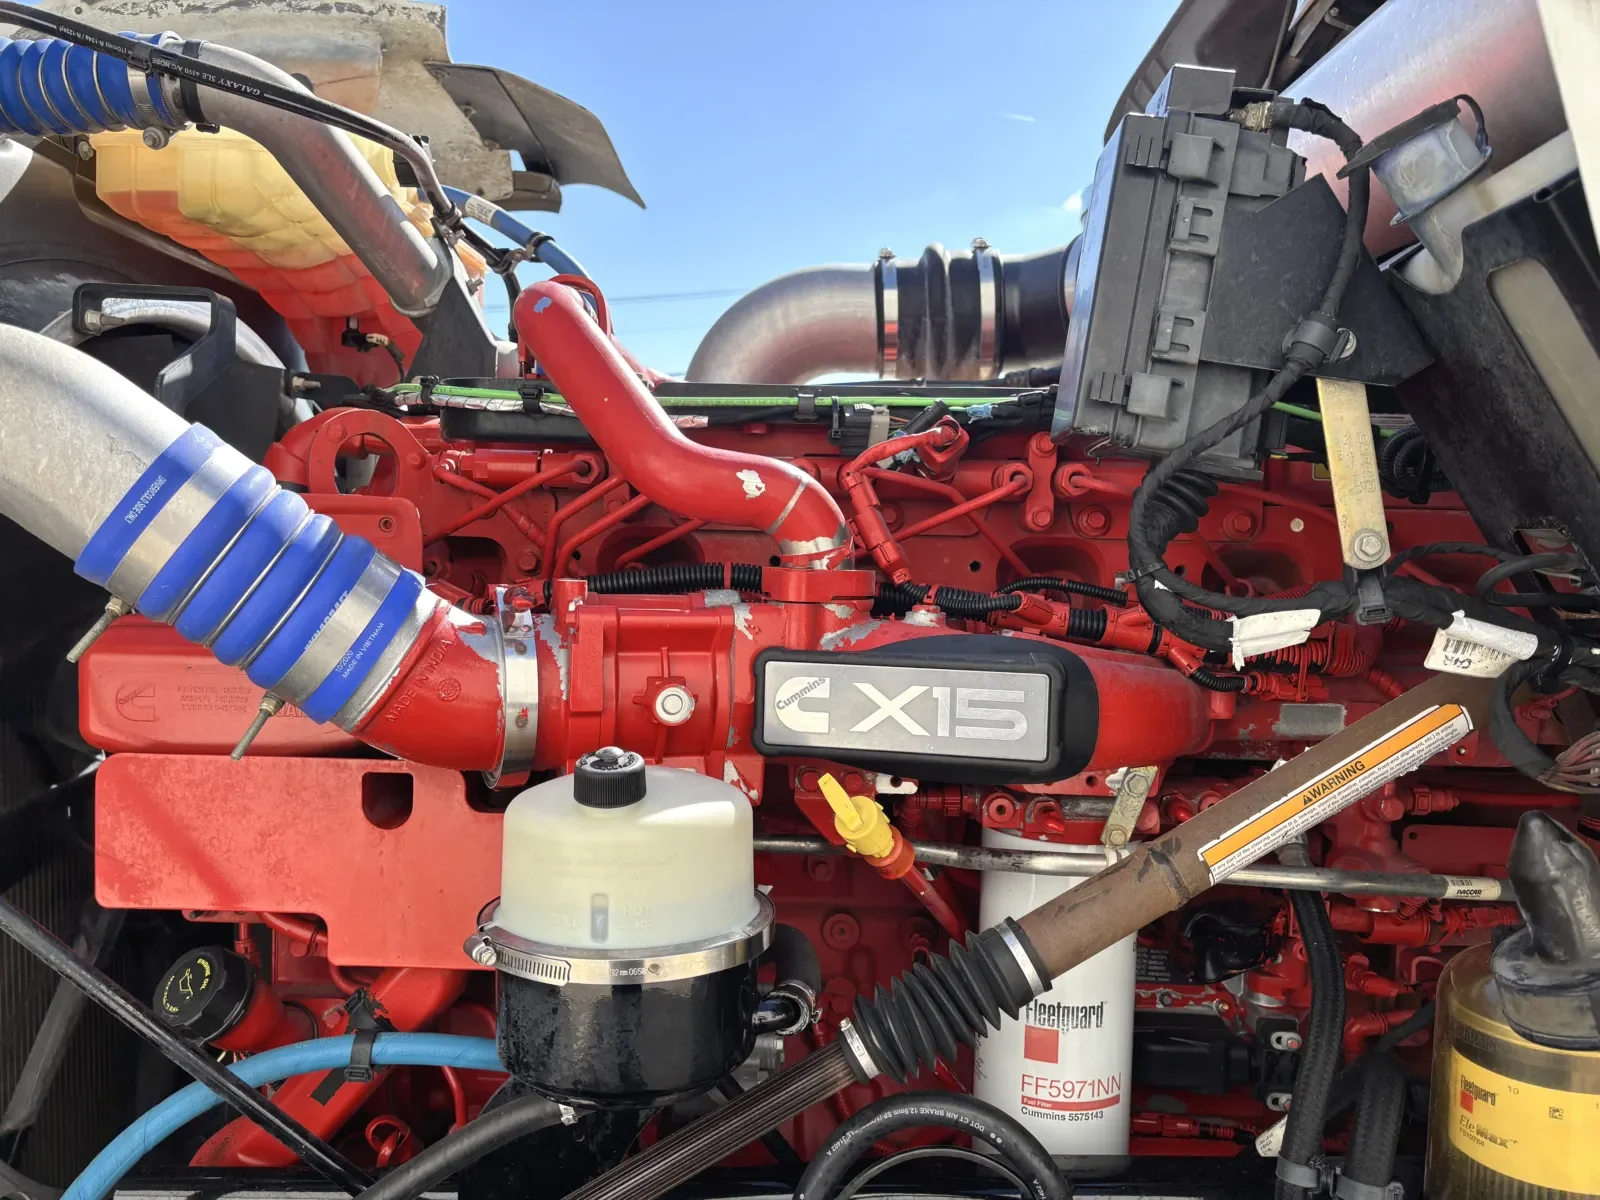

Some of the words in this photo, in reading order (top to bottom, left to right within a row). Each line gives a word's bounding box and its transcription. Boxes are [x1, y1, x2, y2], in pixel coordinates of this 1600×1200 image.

[202, 73, 217, 82] SLE
[217, 76, 260, 96] GALAXY
[132, 500, 145, 513] SIDE
[123, 510, 137, 524] ONLY
[342, 660, 358, 679] MADE
[356, 652, 364, 661] IN
[361, 622, 385, 652] VIETNAM
[385, 688, 417, 723] MADE
[416, 674, 428, 688] IN
[428, 639, 452, 673] INDIA
[776, 677, 826, 710] Cummins
[849, 682, 1028, 741] X15
[1308, 761, 1366, 800] WARNING
[1250, 834, 1270, 848] steering
[623, 905, 650, 916] HOT
[197, 958, 210, 976] ENGINE
[200, 978, 209, 990] OIL
[1025, 998, 1104, 1035] Fleetguard
[1021, 1072, 1122, 1099] FF5971NN
[1460, 1074, 1496, 1106] Fleetguard
[882, 1110, 892, 1119] SP
[892, 1108, 918, 1116] 12.5mm
[920, 1107, 944, 1116] BRAKE
[946, 1112, 958, 1120] AIR
[1021, 1106, 1066, 1121] Cummins
[1068, 1110, 1104, 1122] 5575143
[970, 1121, 985, 1132] DOT
[830, 1136, 846, 1152] J1402
